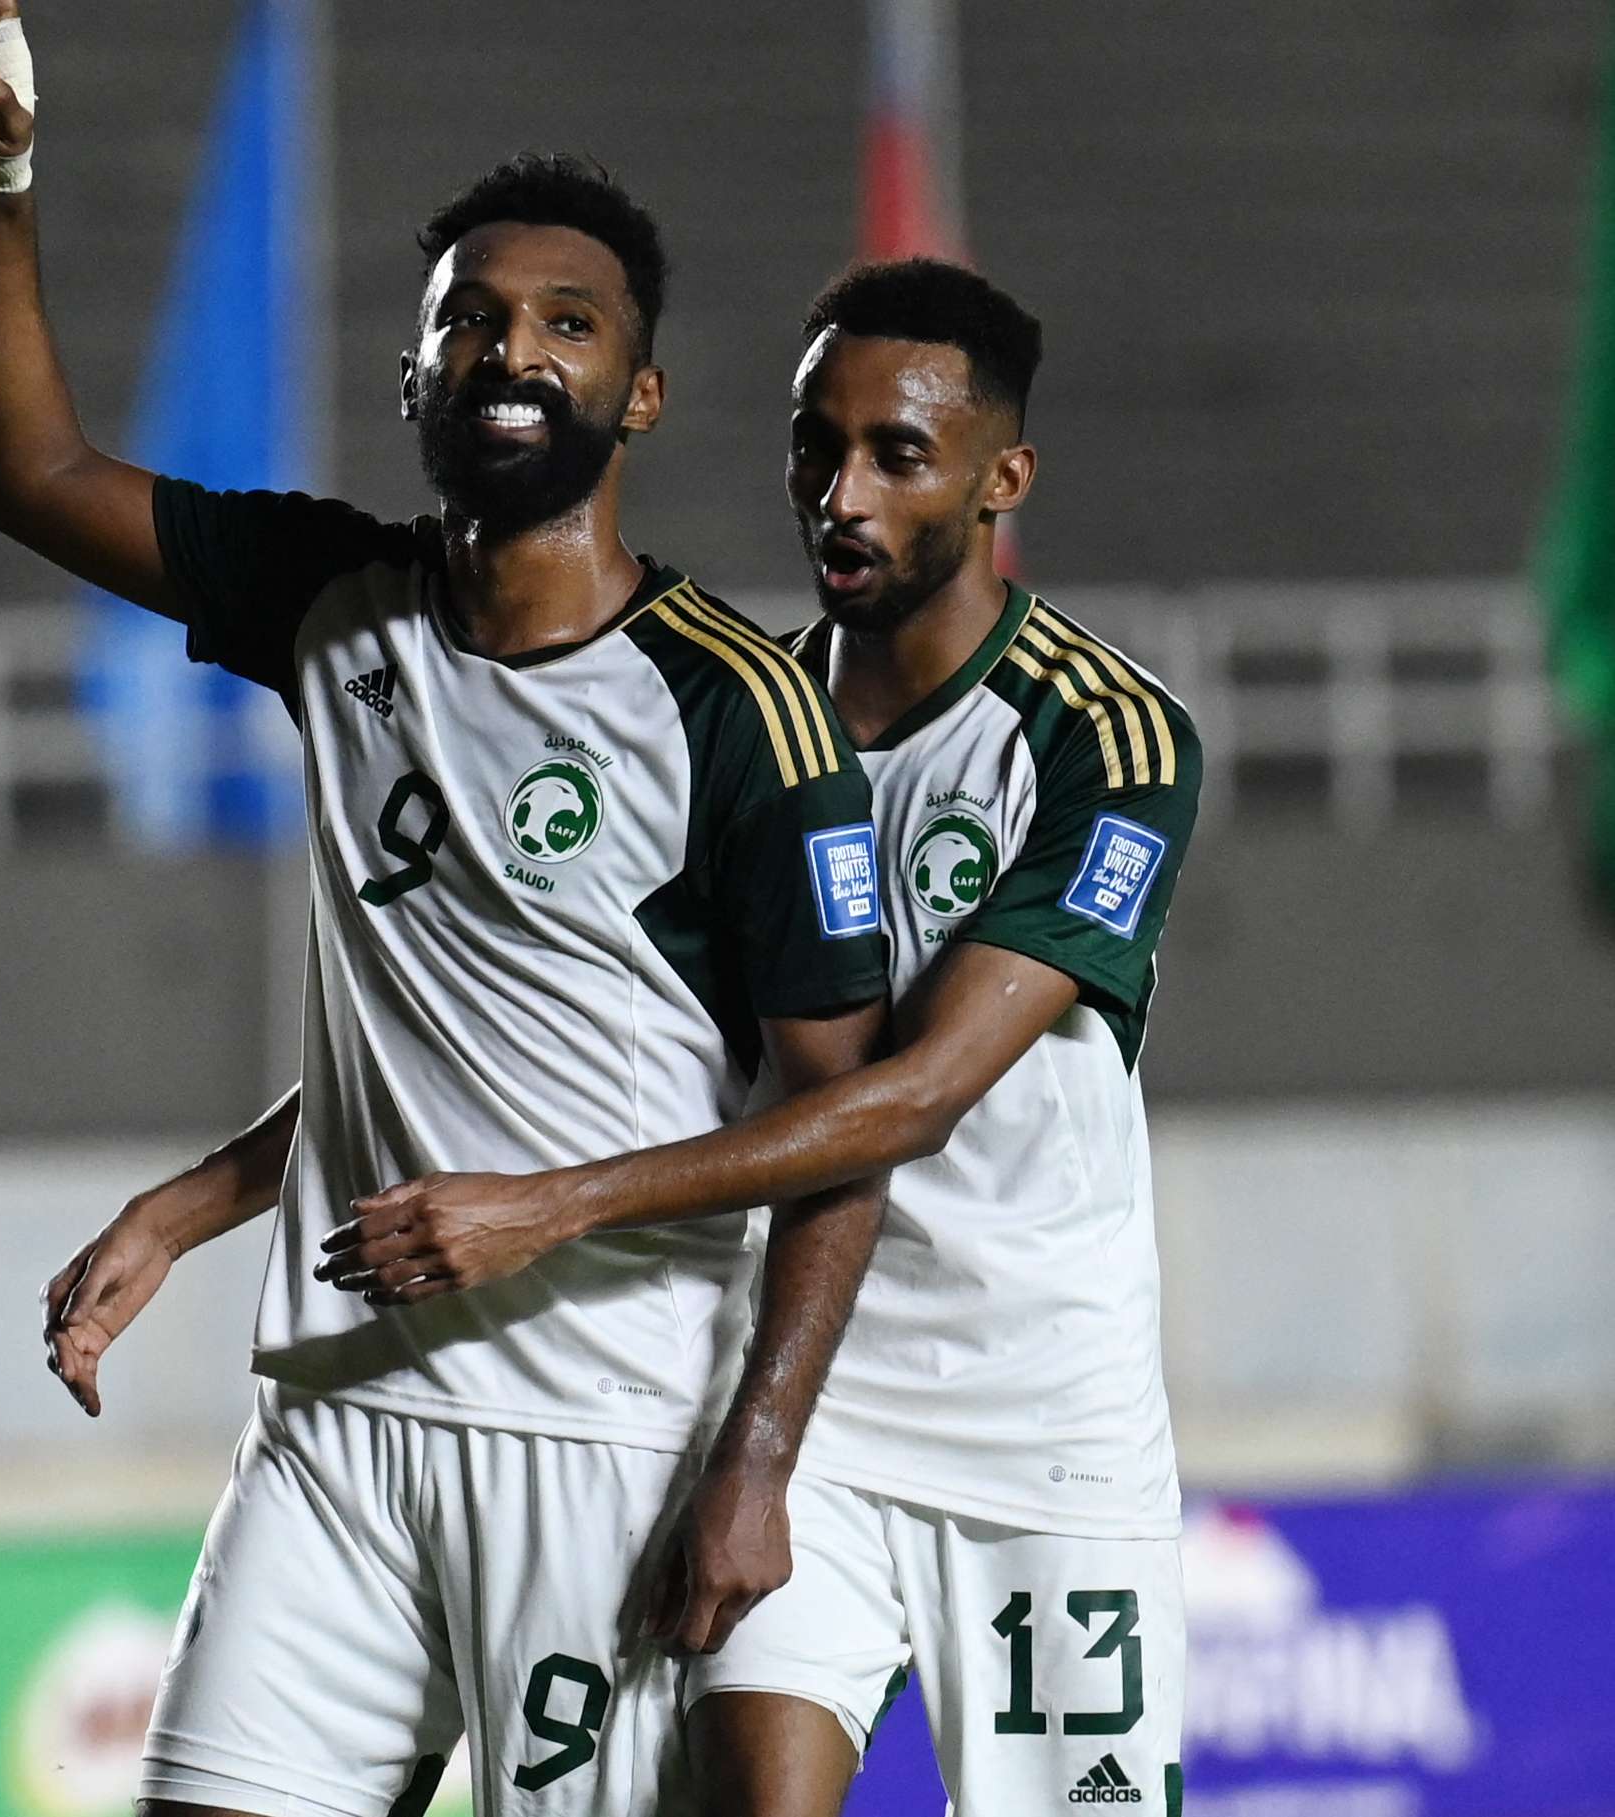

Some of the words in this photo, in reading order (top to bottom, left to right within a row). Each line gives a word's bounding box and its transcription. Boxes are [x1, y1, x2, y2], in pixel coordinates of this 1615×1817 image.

[344, 679, 394, 718] adidas
[544, 732, 614, 770] السعودية
[926, 789, 996, 812] السعودية
[357, 770, 451, 908] 9
[548, 822, 577, 840] SAFF
[827, 842, 868, 862] FOOTBALL
[1103, 848, 1146, 881] UNITES
[1109, 834, 1152, 865] FOOTBALL
[503, 864, 555, 893] SAUDI
[830, 857, 871, 882] UNITES
[953, 876, 982, 887] SAFF
[990, 1588, 1144, 1736] 13
[513, 1652, 611, 1792] 9
[1068, 1785, 1142, 1803] adidas
